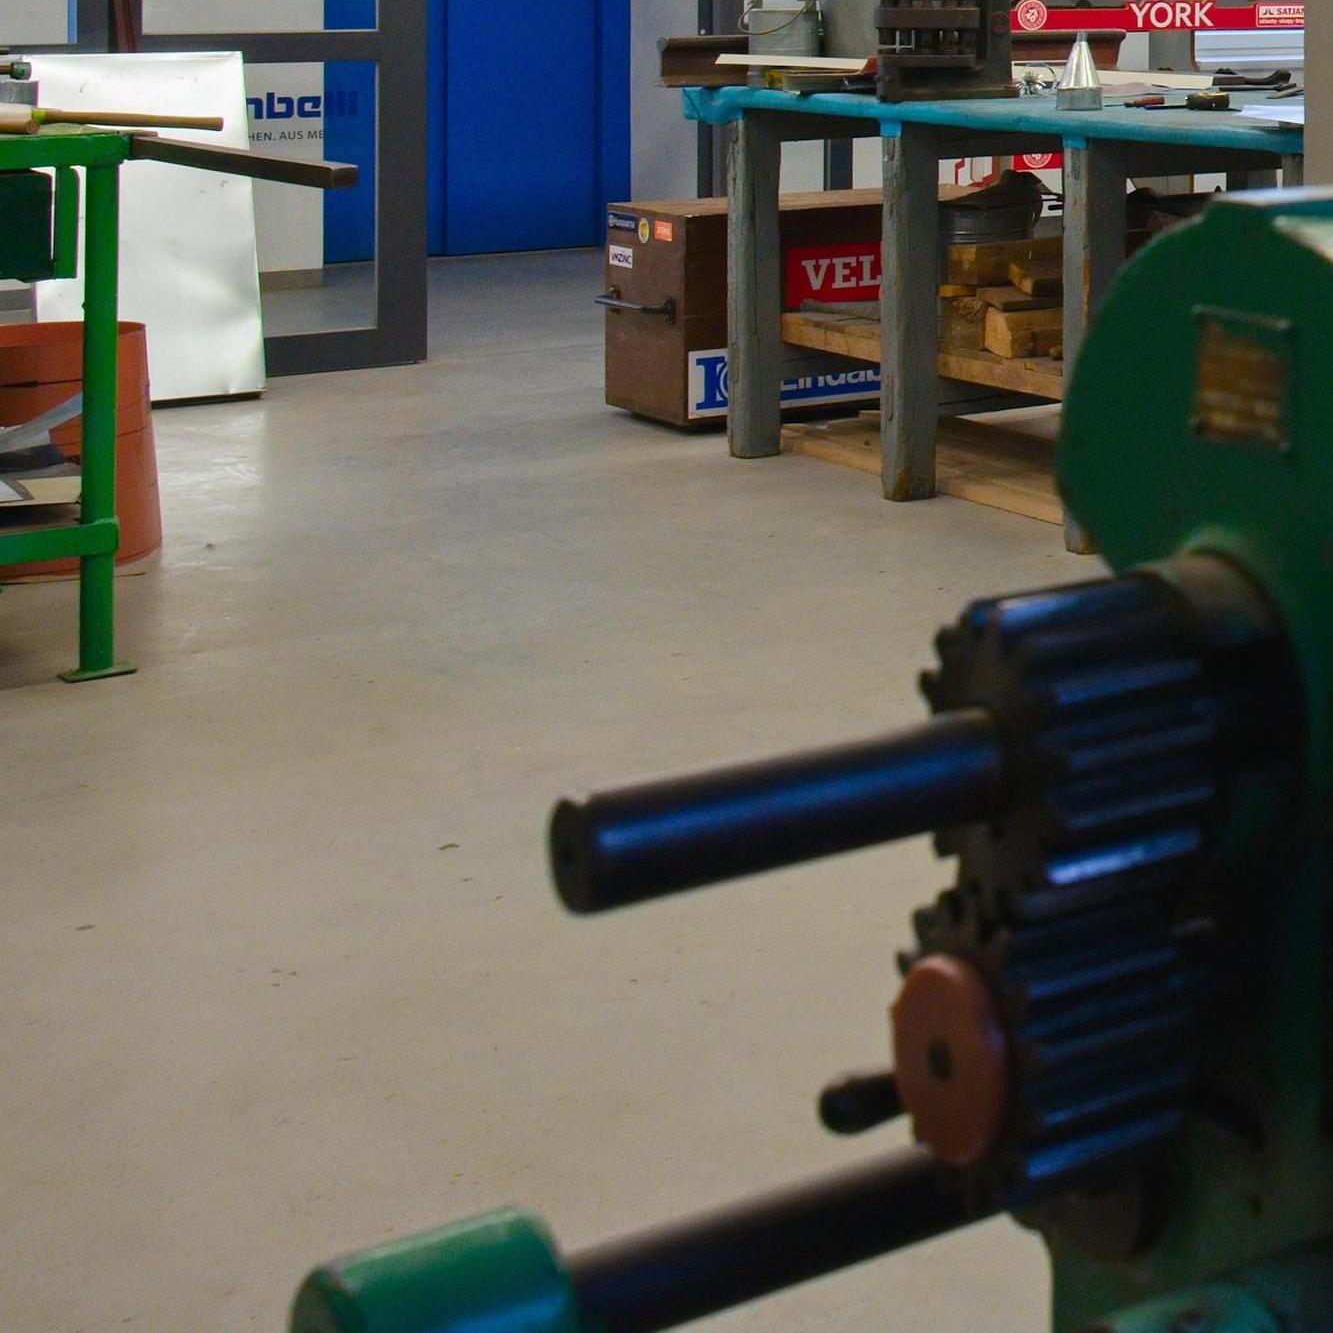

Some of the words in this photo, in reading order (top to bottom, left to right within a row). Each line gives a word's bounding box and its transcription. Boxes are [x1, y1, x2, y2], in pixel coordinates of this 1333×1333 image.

[1130, 3, 1214, 27] YORK
[279, 130, 304, 140] AUS
[802, 254, 881, 290] VEL
